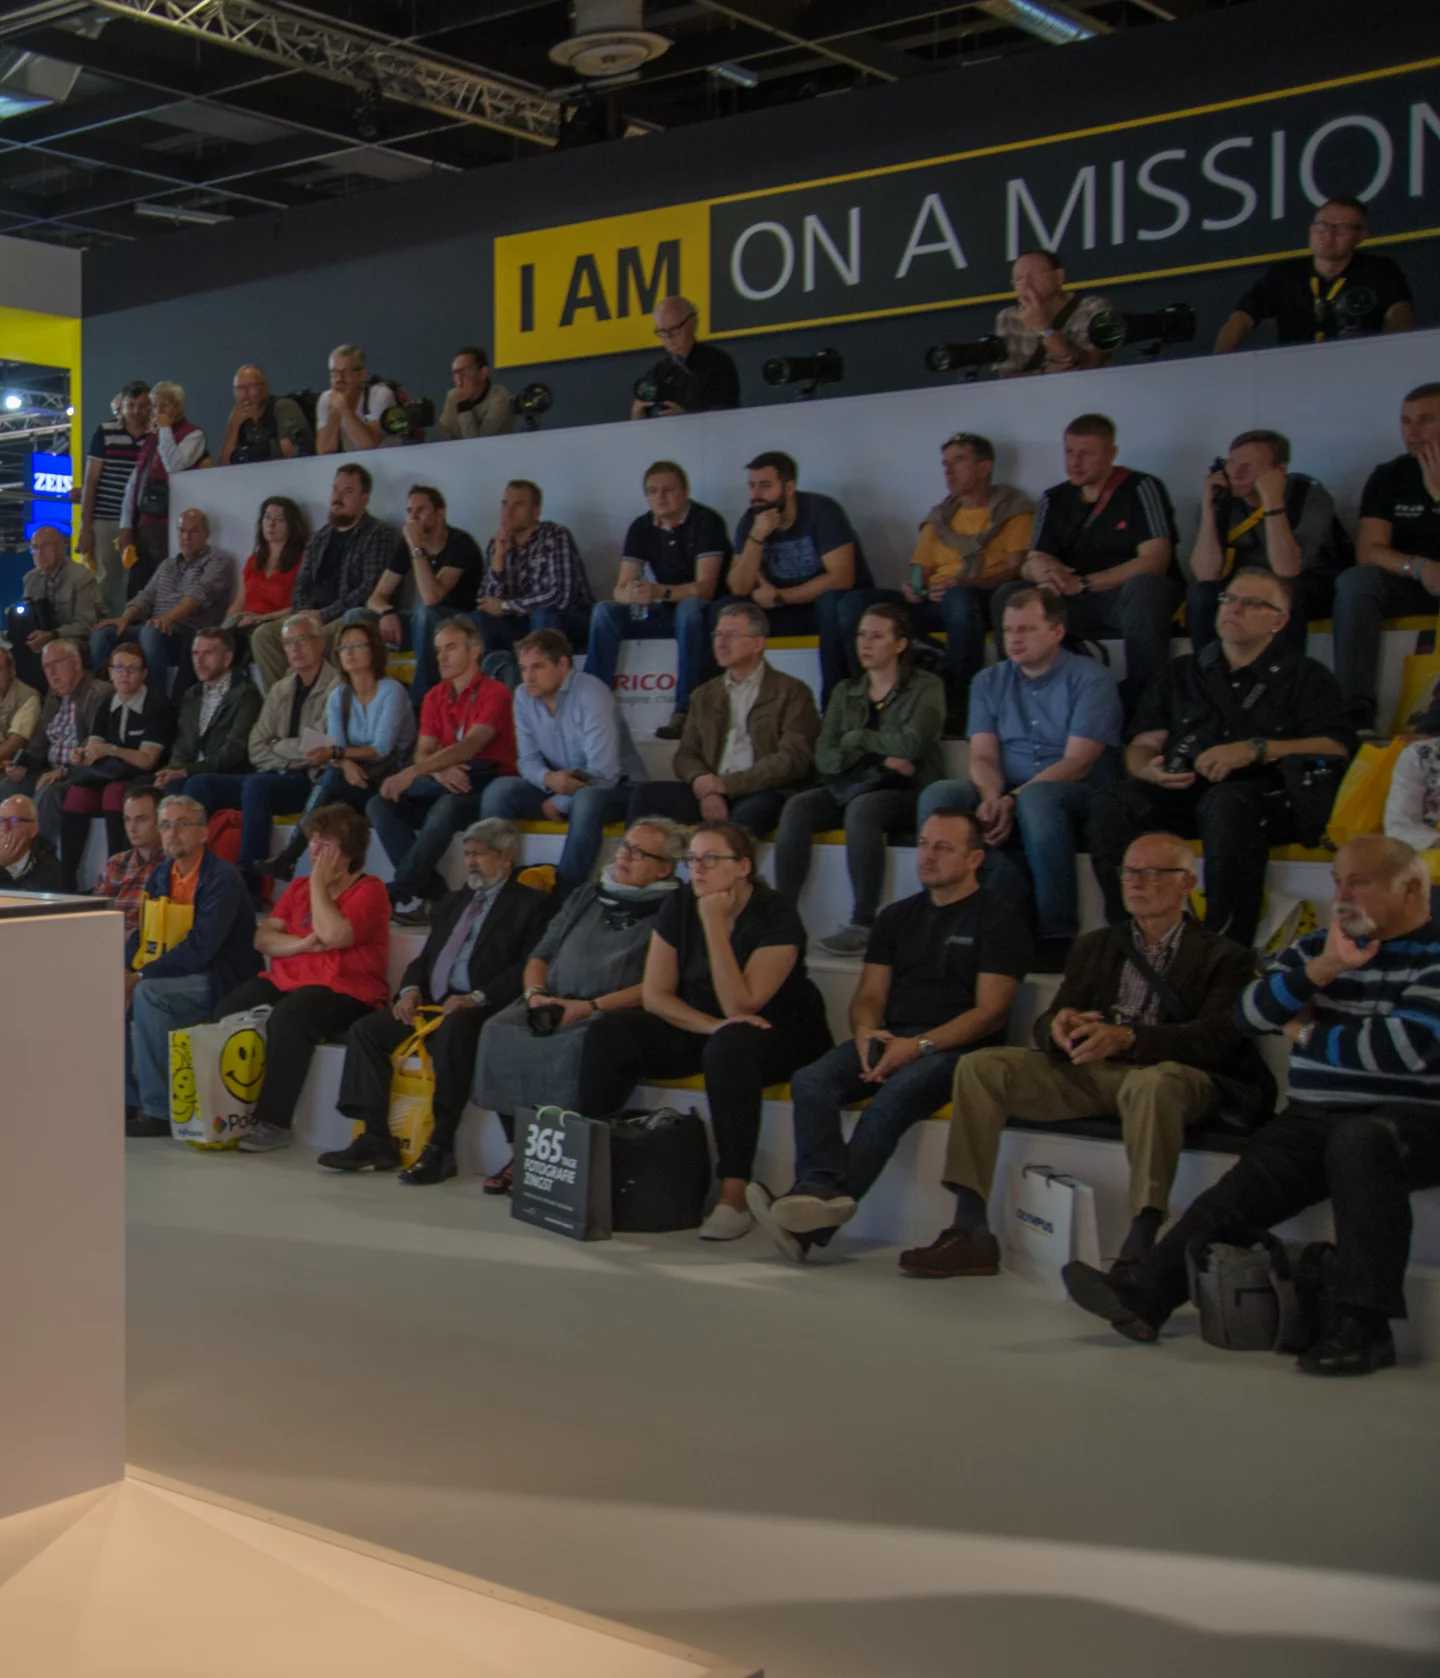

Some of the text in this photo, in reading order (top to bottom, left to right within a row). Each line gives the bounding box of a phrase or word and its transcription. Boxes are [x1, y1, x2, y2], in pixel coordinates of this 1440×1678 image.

[520, 263, 534, 333] I
[559, 239, 681, 327] AM
[730, 207, 860, 301] ON
[894, 193, 968, 278] A
[34, 472, 73, 493] ZEIS
[612, 673, 676, 691] RICO
[524, 1123, 566, 1164] 365
[523, 1158, 577, 1185] FOTOGRAFIE
[1016, 1208, 1054, 1234] OLYMPUS
